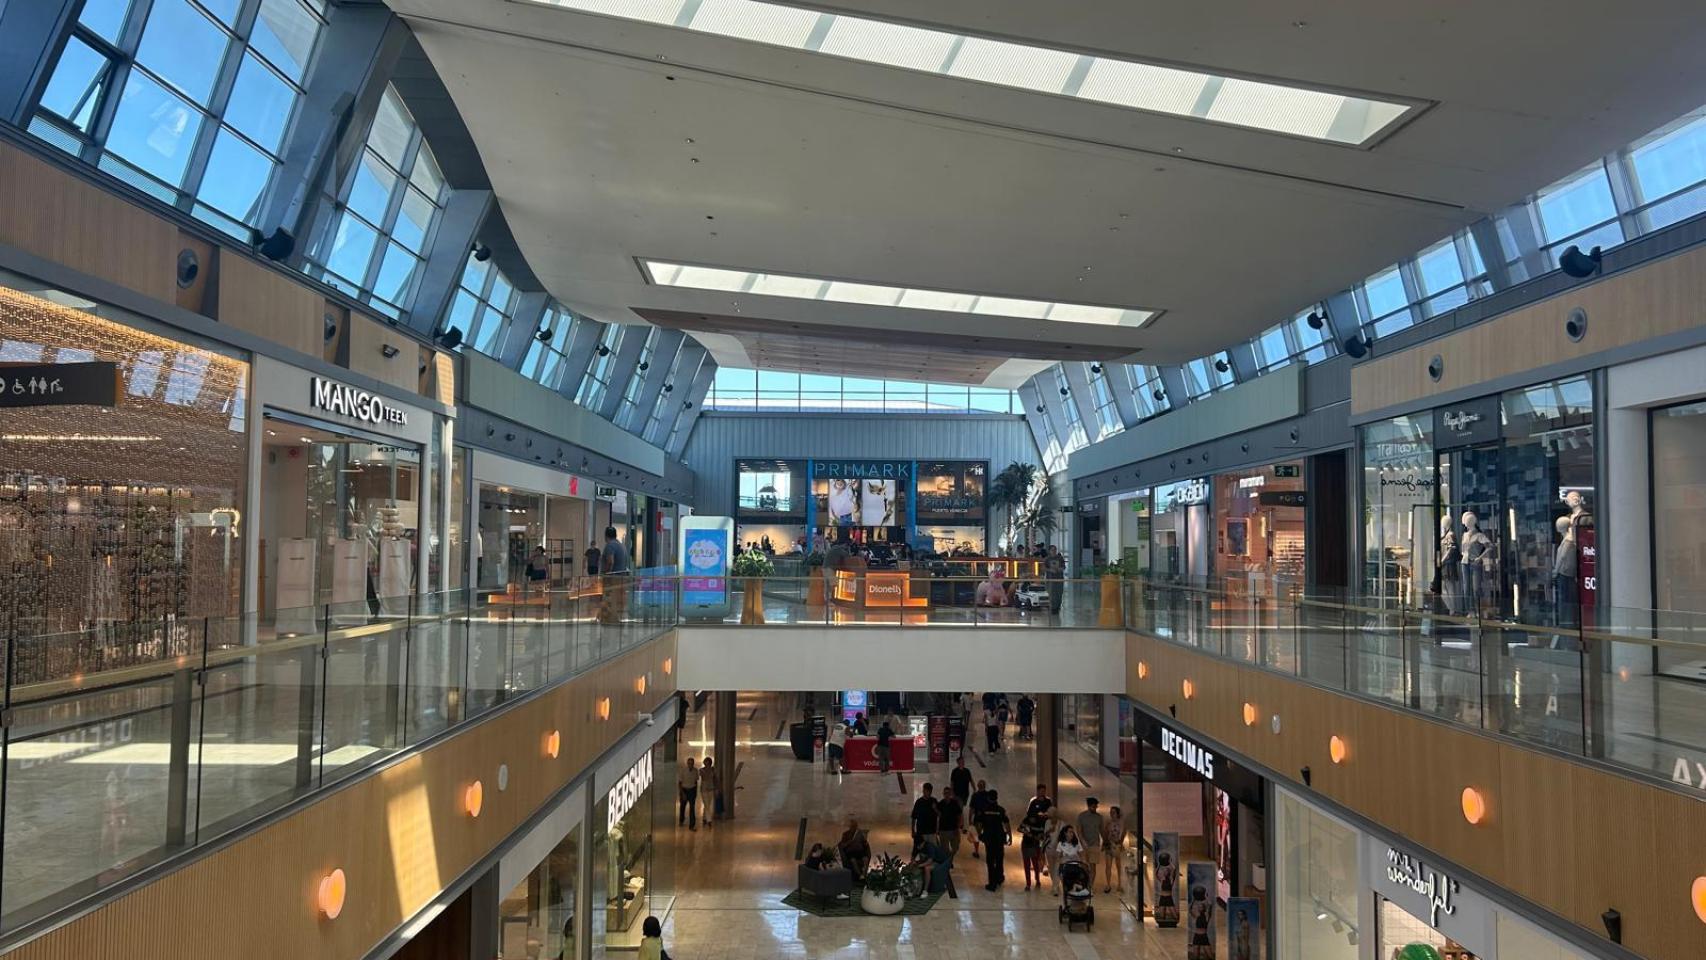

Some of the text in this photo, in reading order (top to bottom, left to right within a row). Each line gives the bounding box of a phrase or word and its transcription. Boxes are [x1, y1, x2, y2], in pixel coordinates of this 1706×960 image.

[313, 377, 408, 425] MANGO TEEN
[814, 463, 909, 477] PRIMARK
[923, 497, 977, 508] PRIMARK
[869, 584, 902, 595] Dionelly
[1161, 727, 1214, 780] DECIMAS
[607, 749, 654, 831] BERSHKA
